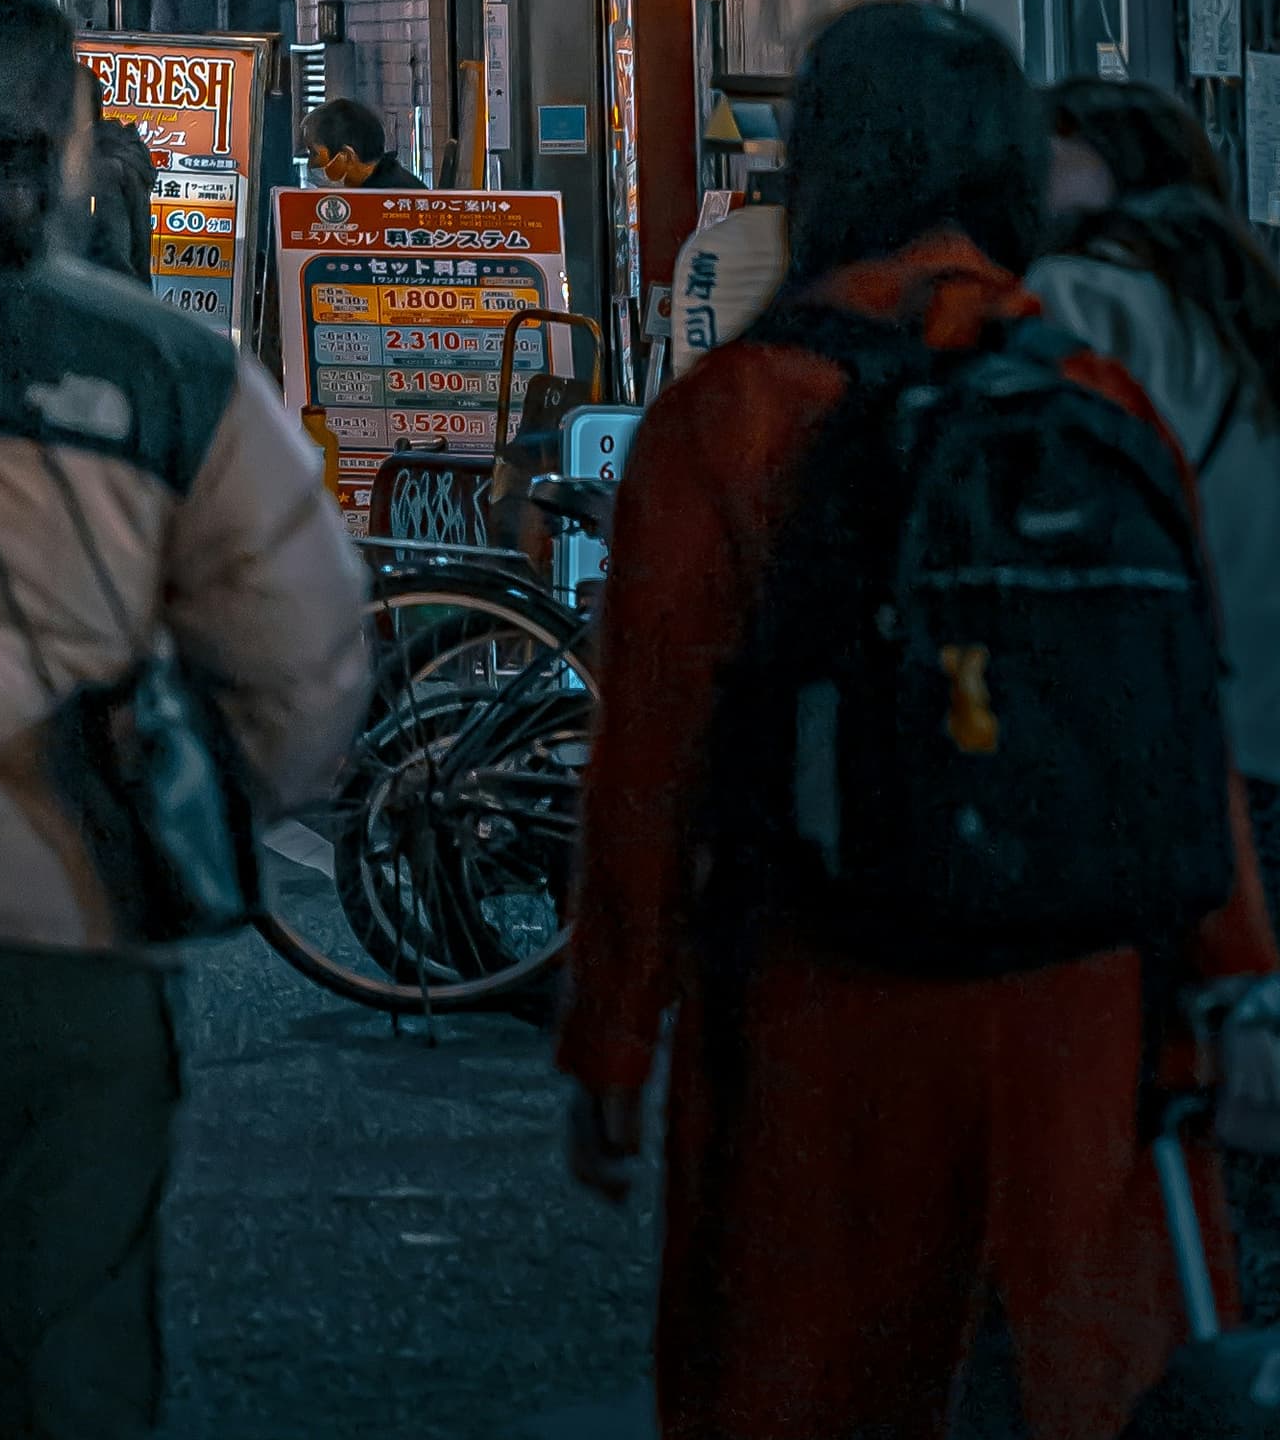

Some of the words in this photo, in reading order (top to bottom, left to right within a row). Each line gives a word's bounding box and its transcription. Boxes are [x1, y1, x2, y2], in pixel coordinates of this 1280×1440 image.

[114, 52, 235, 155] FRESH
[397, 198, 497, 213] 営業のご案内
[166, 209, 232, 233] 60分間
[383, 228, 531, 249] 料金システム
[368, 259, 478, 276] セット料金
[383, 289, 476, 311] 1,800円
[385, 330, 480, 352] 2,310円
[389, 370, 482, 394] 3,190円
[390, 412, 485, 435] 3,520円
